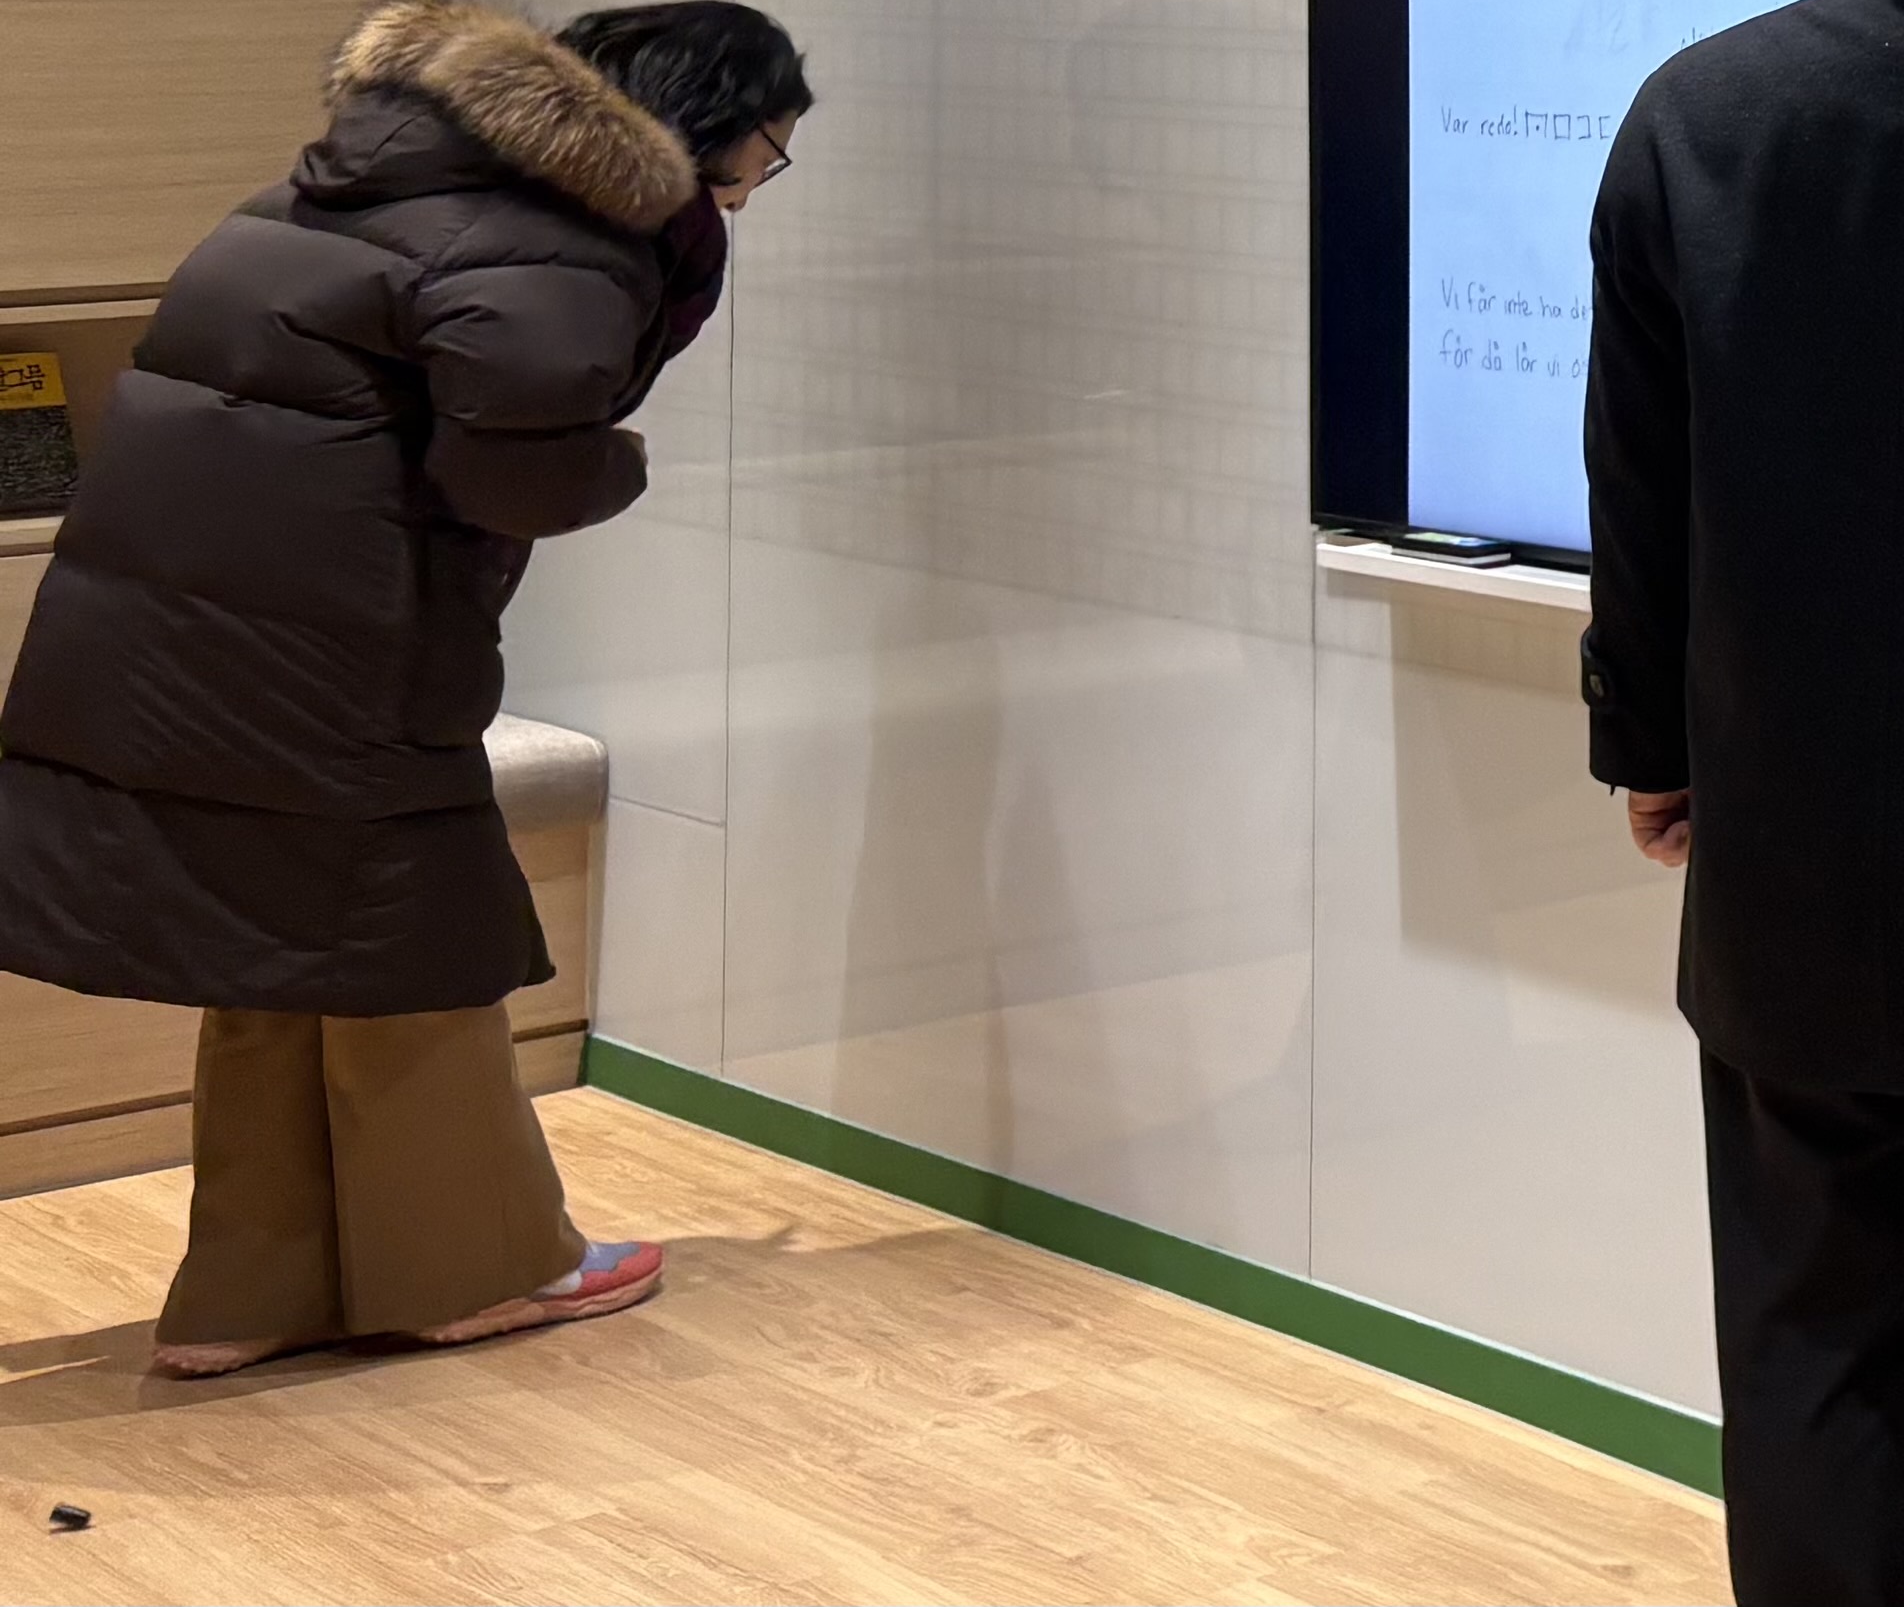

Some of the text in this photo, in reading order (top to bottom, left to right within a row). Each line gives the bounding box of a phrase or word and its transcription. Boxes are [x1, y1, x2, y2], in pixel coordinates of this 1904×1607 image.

[1440, 103, 1470, 134] Var
[1441, 276, 1460, 311] Vi
[1570, 294, 1592, 321] de
